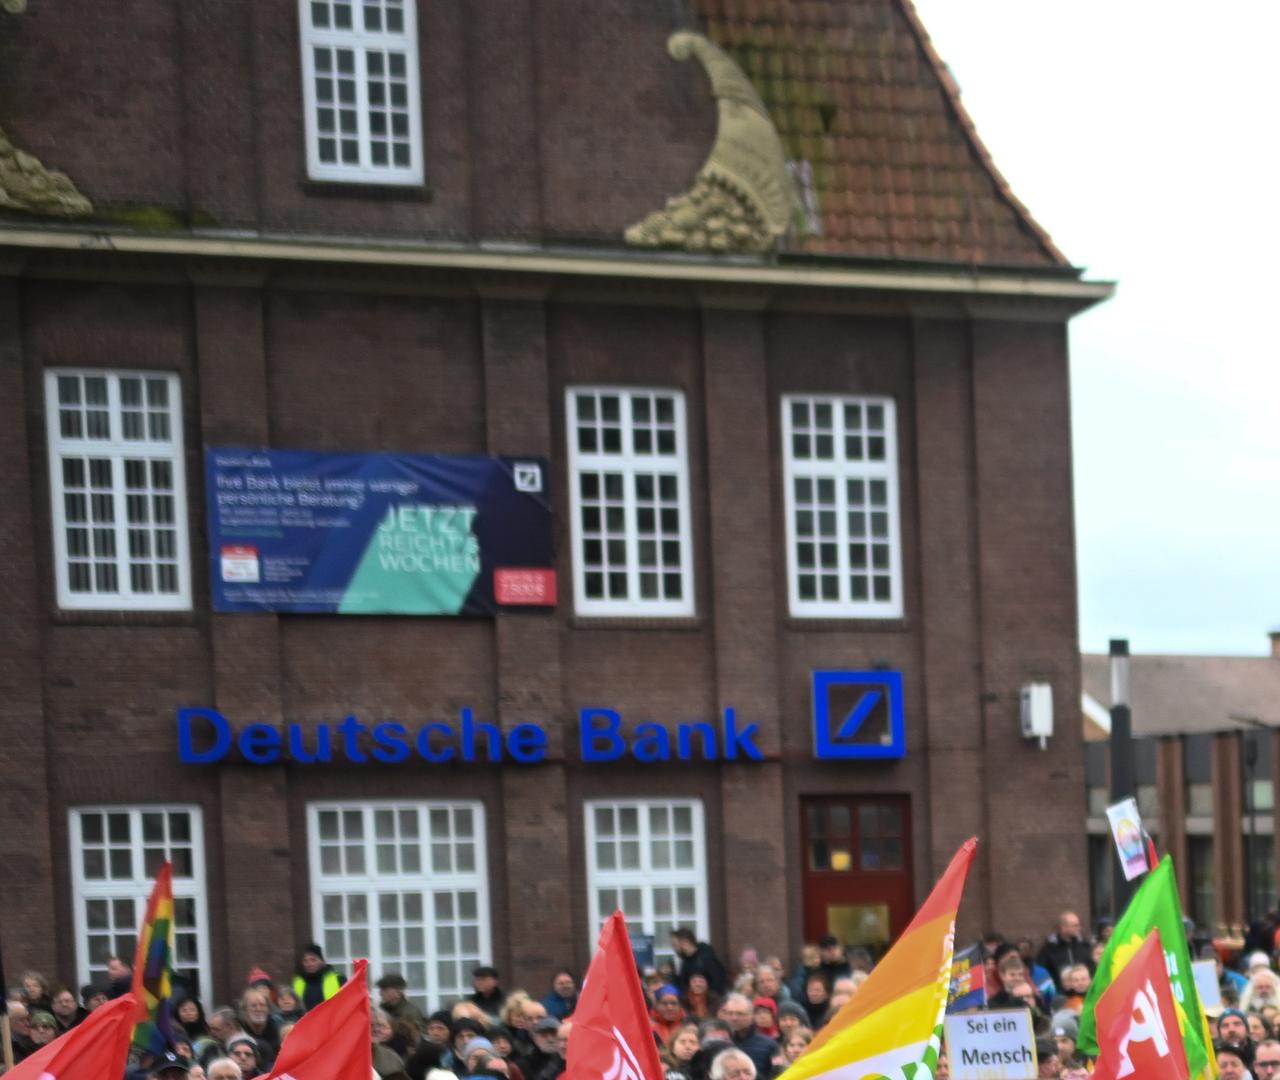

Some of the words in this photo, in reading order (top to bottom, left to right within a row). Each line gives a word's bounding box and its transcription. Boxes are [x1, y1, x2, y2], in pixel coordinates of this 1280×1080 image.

[247, 475, 279, 489] Bank
[379, 504, 478, 532] JETZT
[379, 552, 481, 572] WOCHEN
[177, 707, 547, 764] Deutsche
[579, 707, 764, 764] Bank
[967, 1020, 989, 1033] Sei
[993, 1019, 1016, 1032] ein
[962, 1046, 1032, 1065] Mensch
